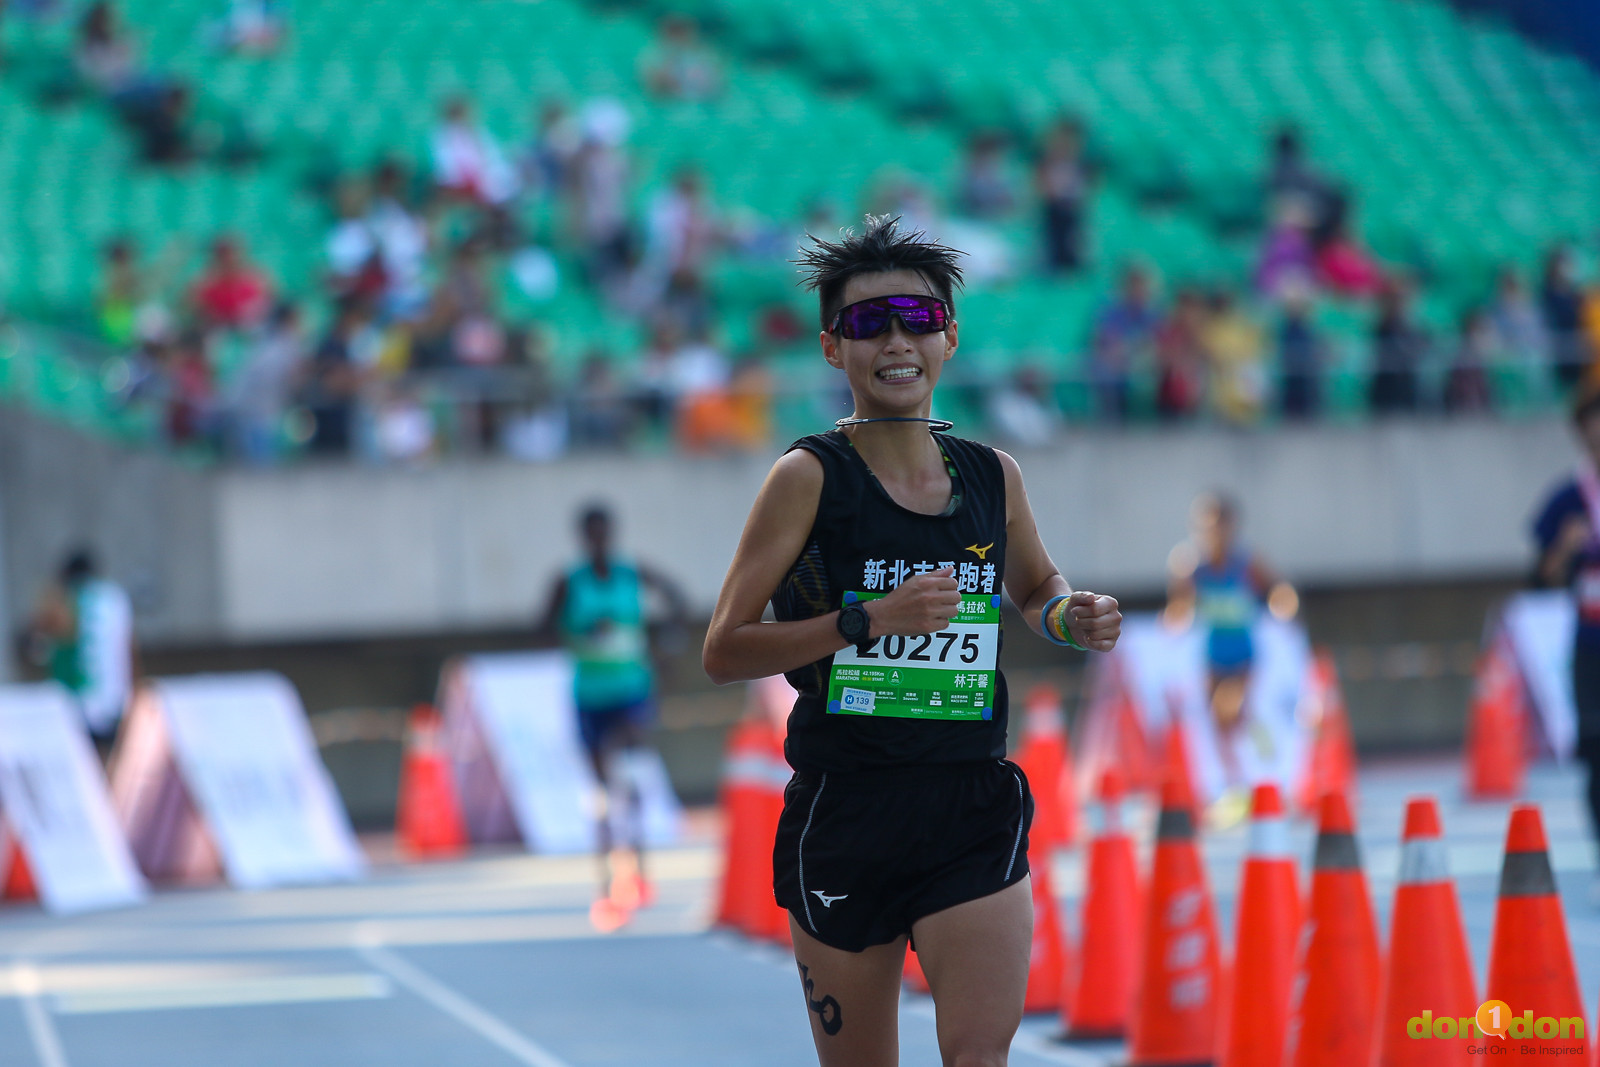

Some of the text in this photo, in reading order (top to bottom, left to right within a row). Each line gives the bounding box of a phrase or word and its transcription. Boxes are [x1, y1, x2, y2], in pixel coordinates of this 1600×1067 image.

[856, 632, 979, 664] 20275
[891, 670, 899, 679] A
[954, 673, 988, 689] 林于馨
[856, 696, 869, 705] 139
